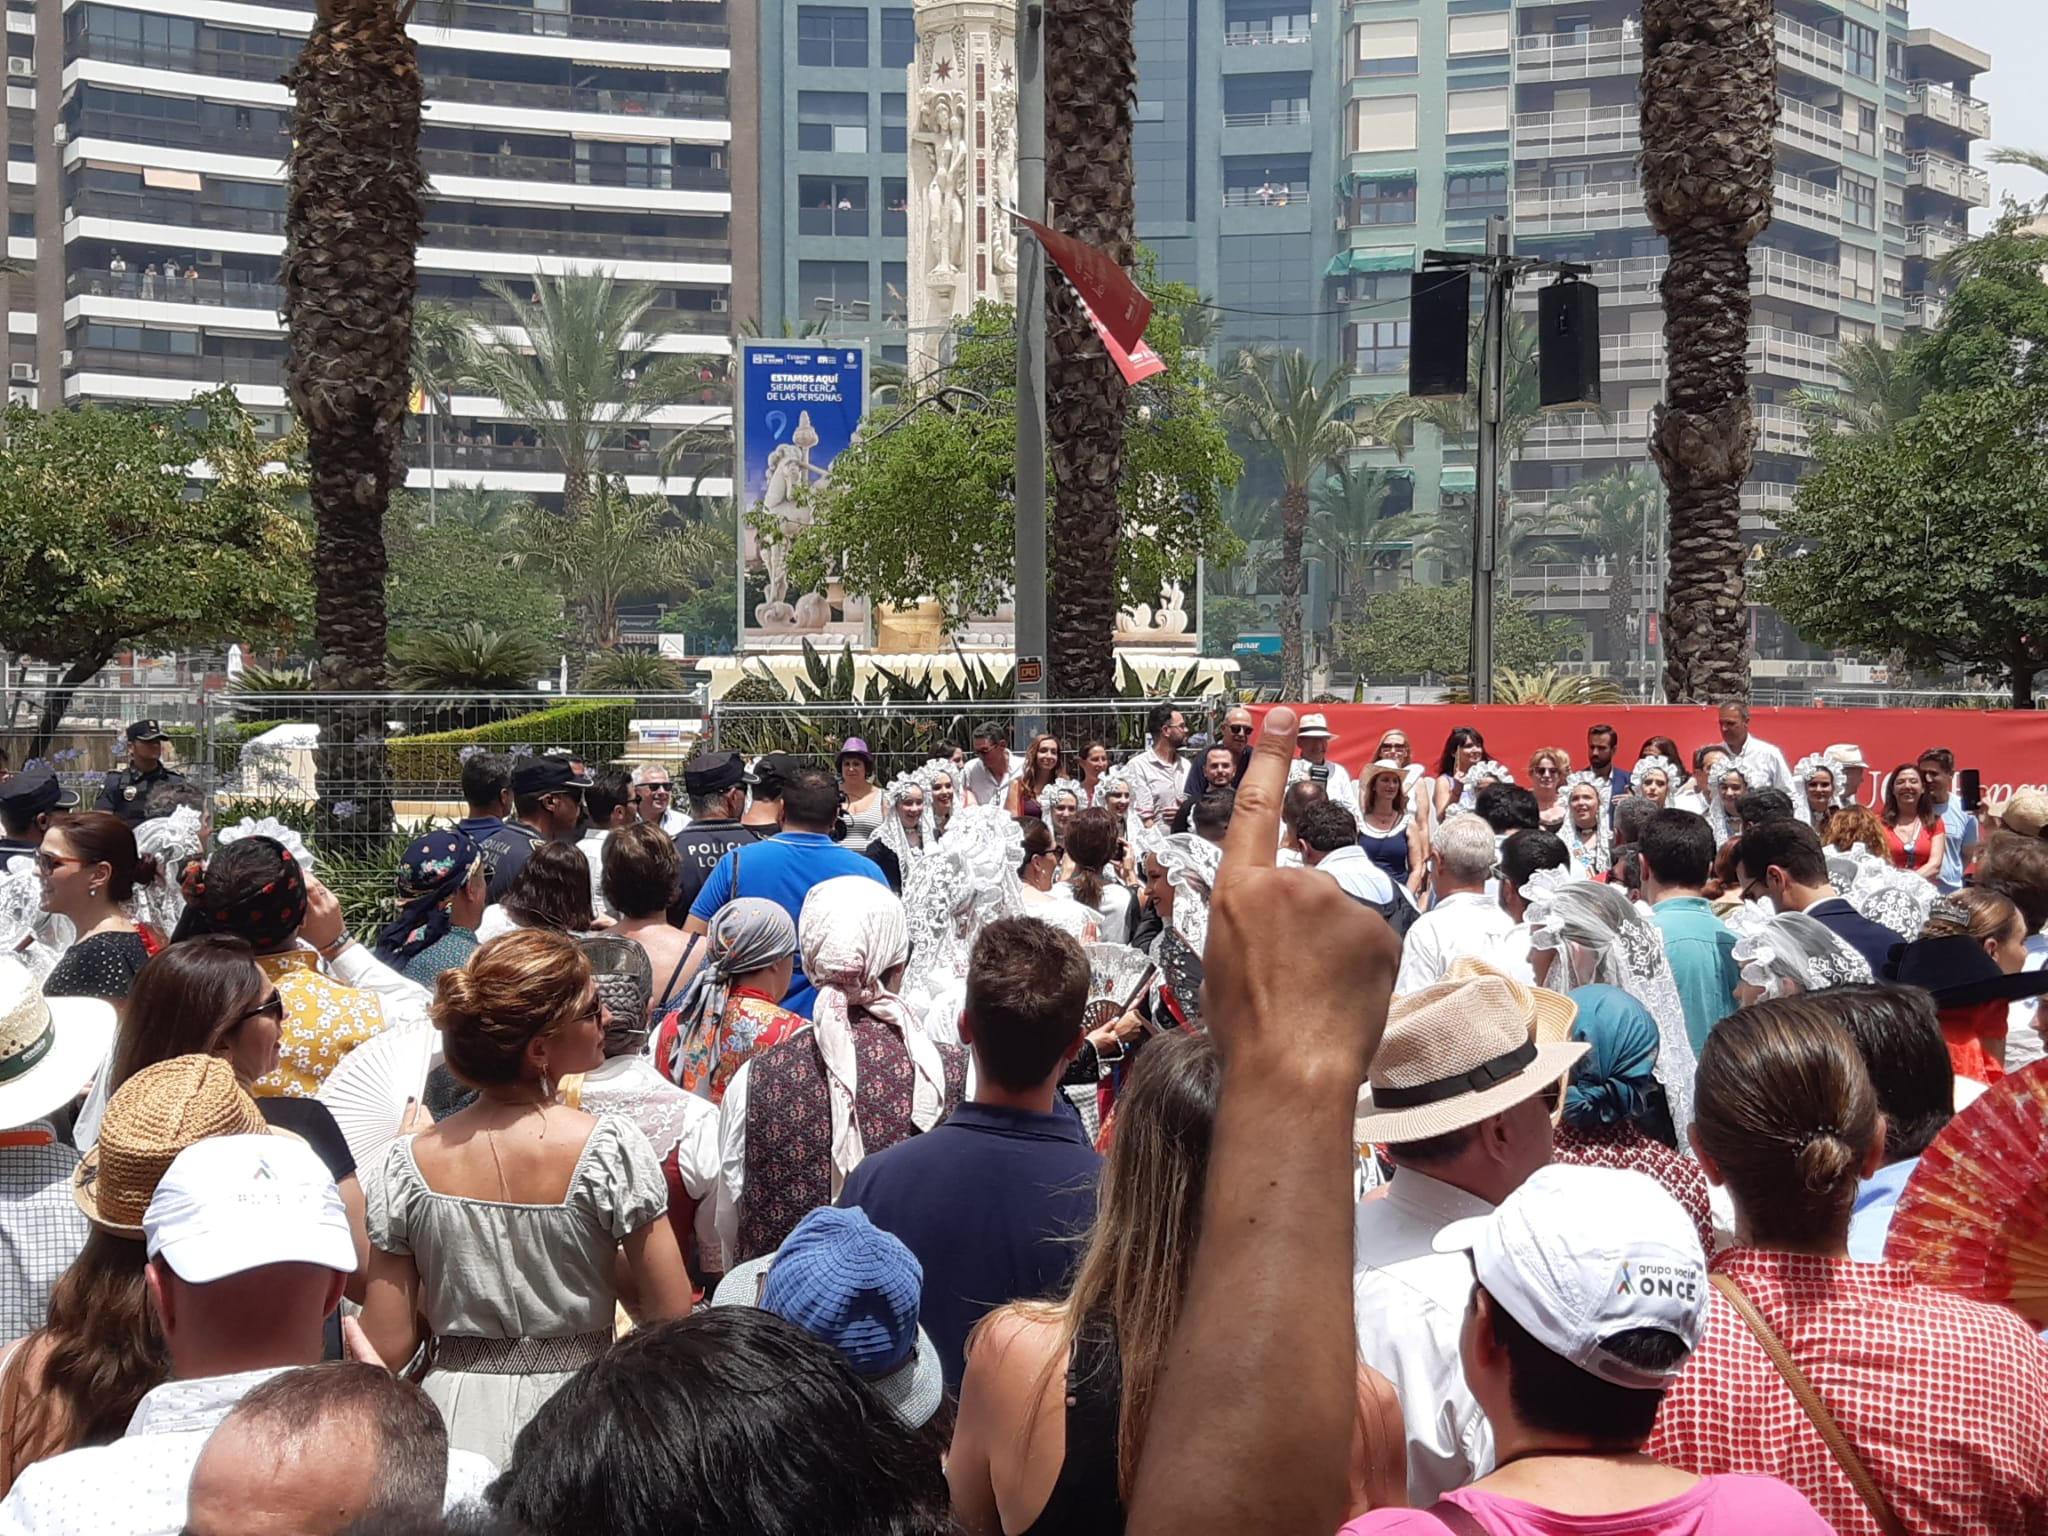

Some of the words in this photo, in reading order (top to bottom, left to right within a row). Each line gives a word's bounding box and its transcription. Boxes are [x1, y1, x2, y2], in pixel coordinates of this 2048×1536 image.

[770, 374, 814, 382] ESTAMOS
[816, 373, 838, 384] AQUÍ
[771, 384, 808, 392] SIEMPRE
[809, 384, 837, 392] CERCA
[780, 393, 796, 401] LAS
[797, 393, 842, 402] PERSONAS
[688, 842, 741, 856] POLIC
[1639, 1264, 1672, 1276] grupo
[1674, 1267, 1696, 1279] social
[1640, 1277, 1695, 1302] ONCE
